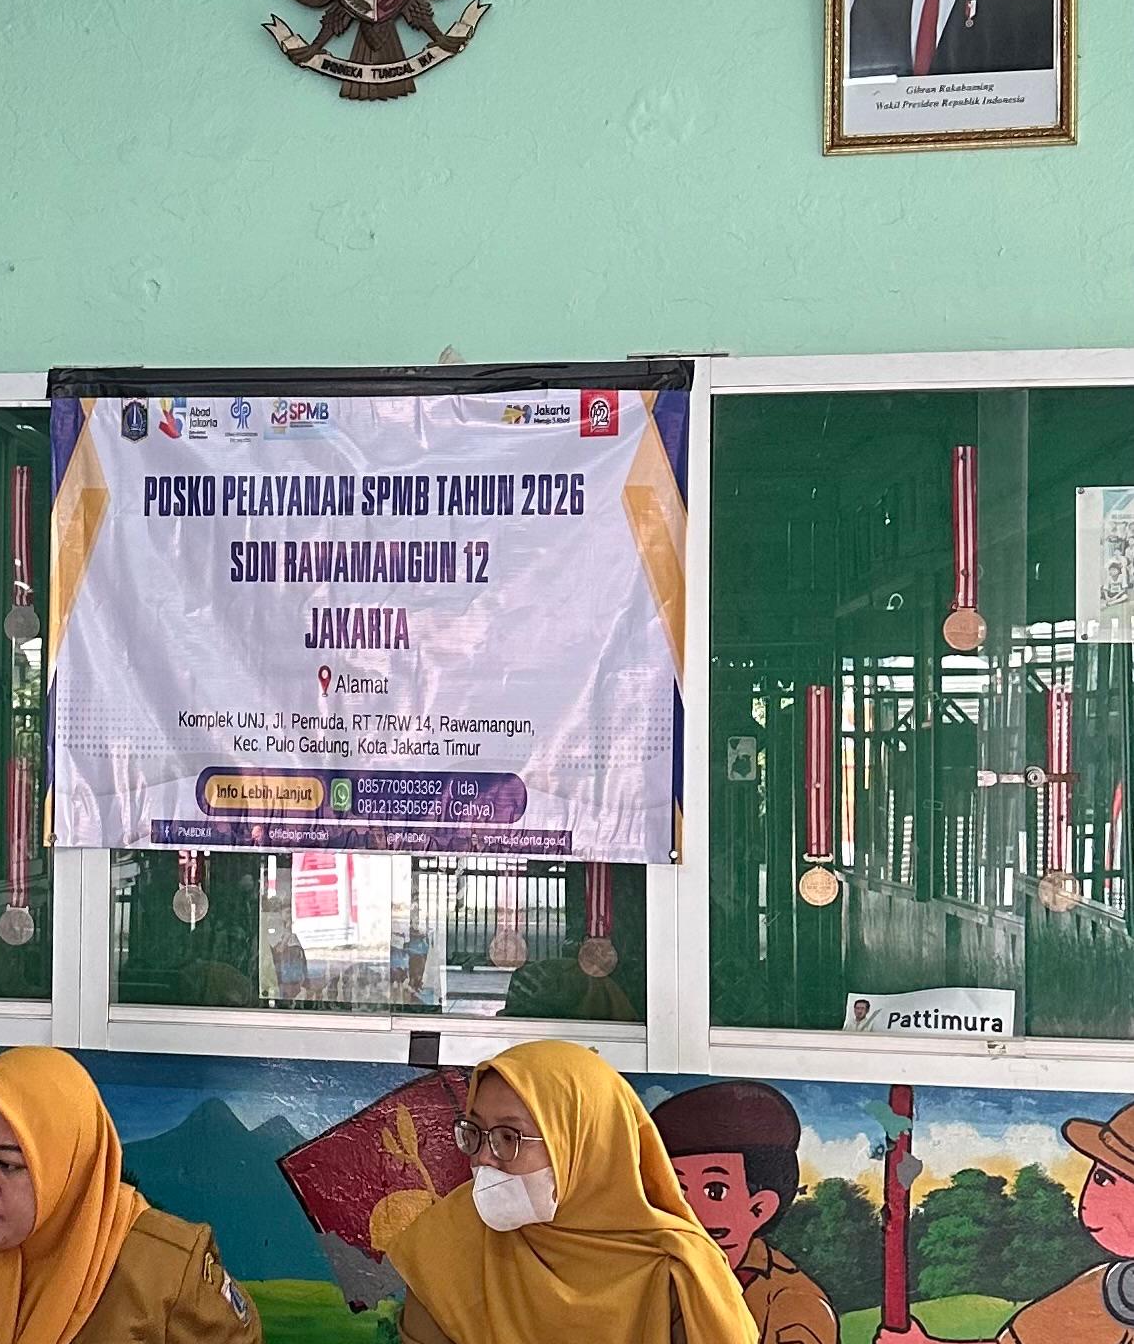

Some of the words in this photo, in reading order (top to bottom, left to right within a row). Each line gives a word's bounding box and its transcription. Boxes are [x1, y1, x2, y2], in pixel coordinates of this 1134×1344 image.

[906, 85, 937, 95] Gibran
[876, 101, 901, 111] Wakil
[903, 100, 939, 110] Presiden
[941, 98, 980, 109] Republik
[982, 96, 1025, 105] Indonesia
[289, 402, 329, 421] SPMB
[534, 404, 570, 416] Jakarta
[144, 475, 216, 517] POSKO
[222, 475, 355, 517] PELAYANAN
[361, 475, 430, 516] SPMB
[436, 474, 515, 516] TAHUN
[521, 473, 585, 516] 2026
[230, 541, 277, 582] SDN
[284, 541, 457, 583] RAWAMANGUN
[463, 541, 490, 583] 12
[305, 607, 410, 649] JAKARTA
[335, 674, 389, 694] Alamat
[178, 711, 234, 731] Komplek
[237, 712, 268, 731] UNJ,
[273, 712, 287, 729] Jl.
[292, 713, 348, 732] Pemuda,
[352, 714, 372, 731] RT
[375, 714, 412, 732] 7/RW
[416, 715, 435, 734] 14,
[440, 715, 535, 737] Rawamangun,
[233, 735, 262, 753] Kec.
[266, 736, 295, 753] Pulo
[299, 736, 353, 758] Gadung,
[358, 738, 387, 755] Kota
[391, 738, 440, 756] Jakarta
[443, 739, 481, 756] Timur
[217, 784, 238, 799] Info
[241, 784, 273, 800] Lebih
[276, 784, 312, 803] Lanjut
[357, 778, 442, 795] 085770903362
[357, 798, 442, 816] 081213505926
[449, 800, 495, 819] (Cahya)
[887, 1008, 1003, 1033] Pattimura
